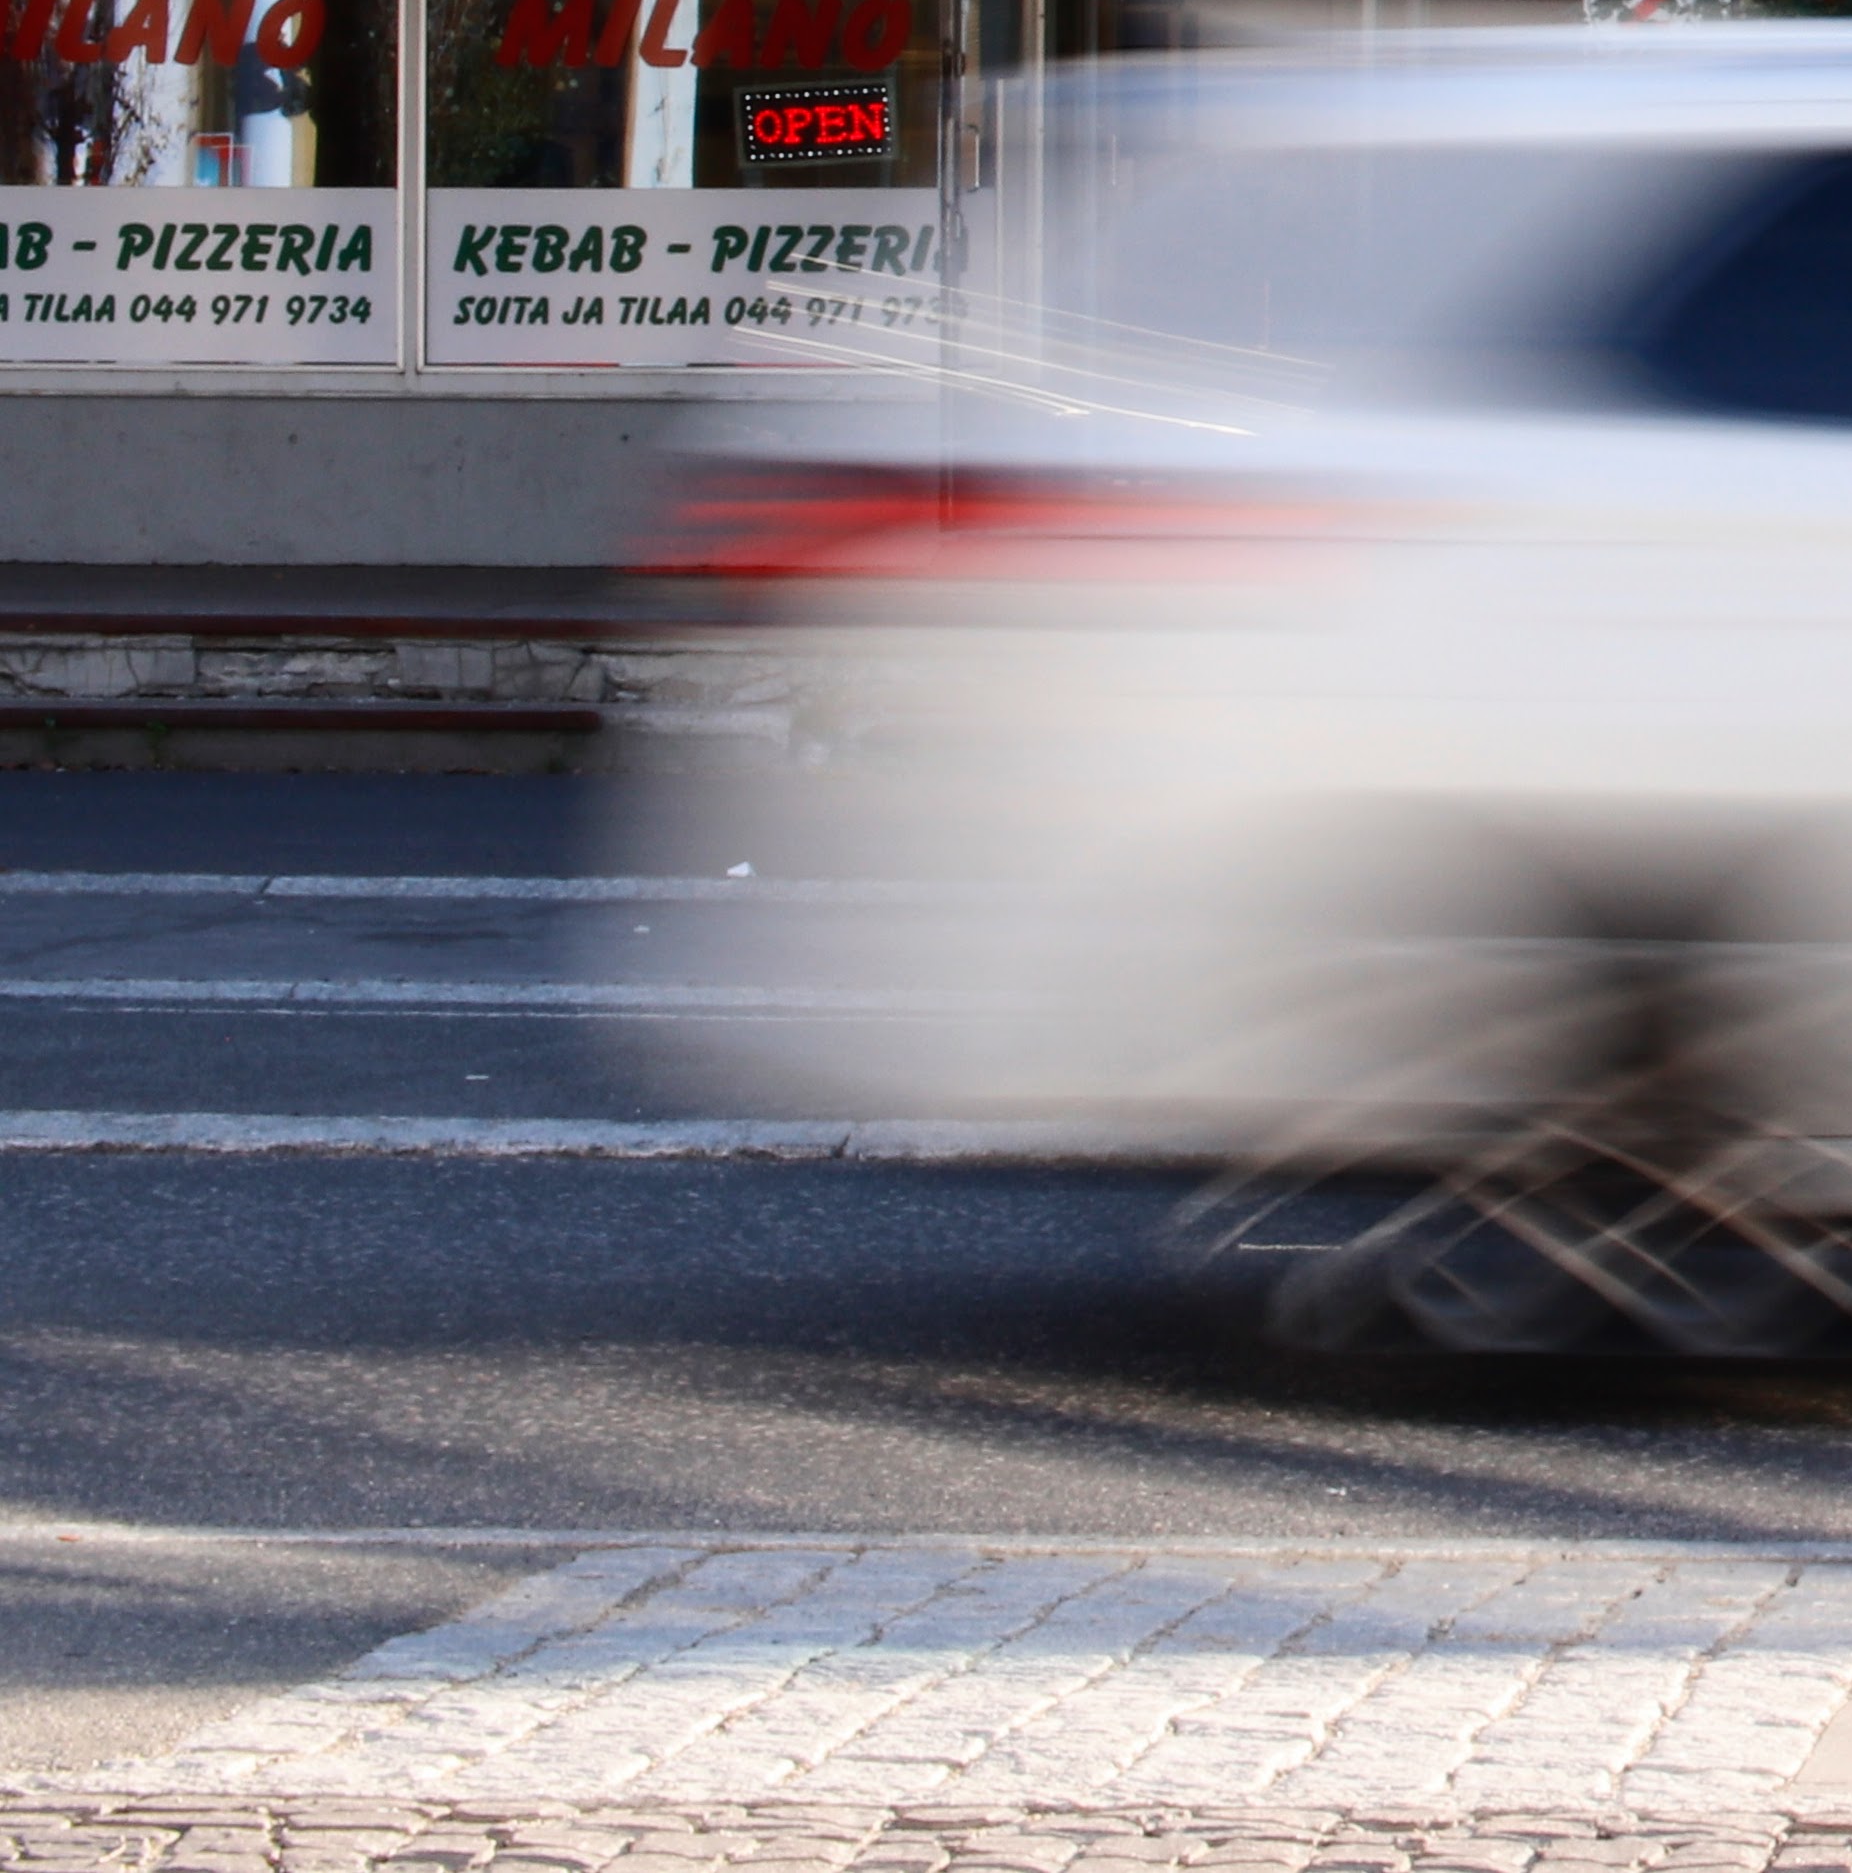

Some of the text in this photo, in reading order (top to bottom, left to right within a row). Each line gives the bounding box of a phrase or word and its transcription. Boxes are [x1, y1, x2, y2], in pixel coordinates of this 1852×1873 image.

[753, 103, 887, 145] OPEN
[116, 221, 373, 276] PIZZERIA
[453, 224, 647, 277] KEBAB
[23, 293, 116, 324] TILAA
[129, 293, 197, 324] 044
[211, 293, 270, 326] 971
[285, 294, 373, 326] 9734
[453, 296, 548, 326] SOITA
[562, 296, 605, 326] JA
[618, 296, 711, 326] TILAA
[725, 296, 793, 326] 044
[806, 296, 864, 327] 971
